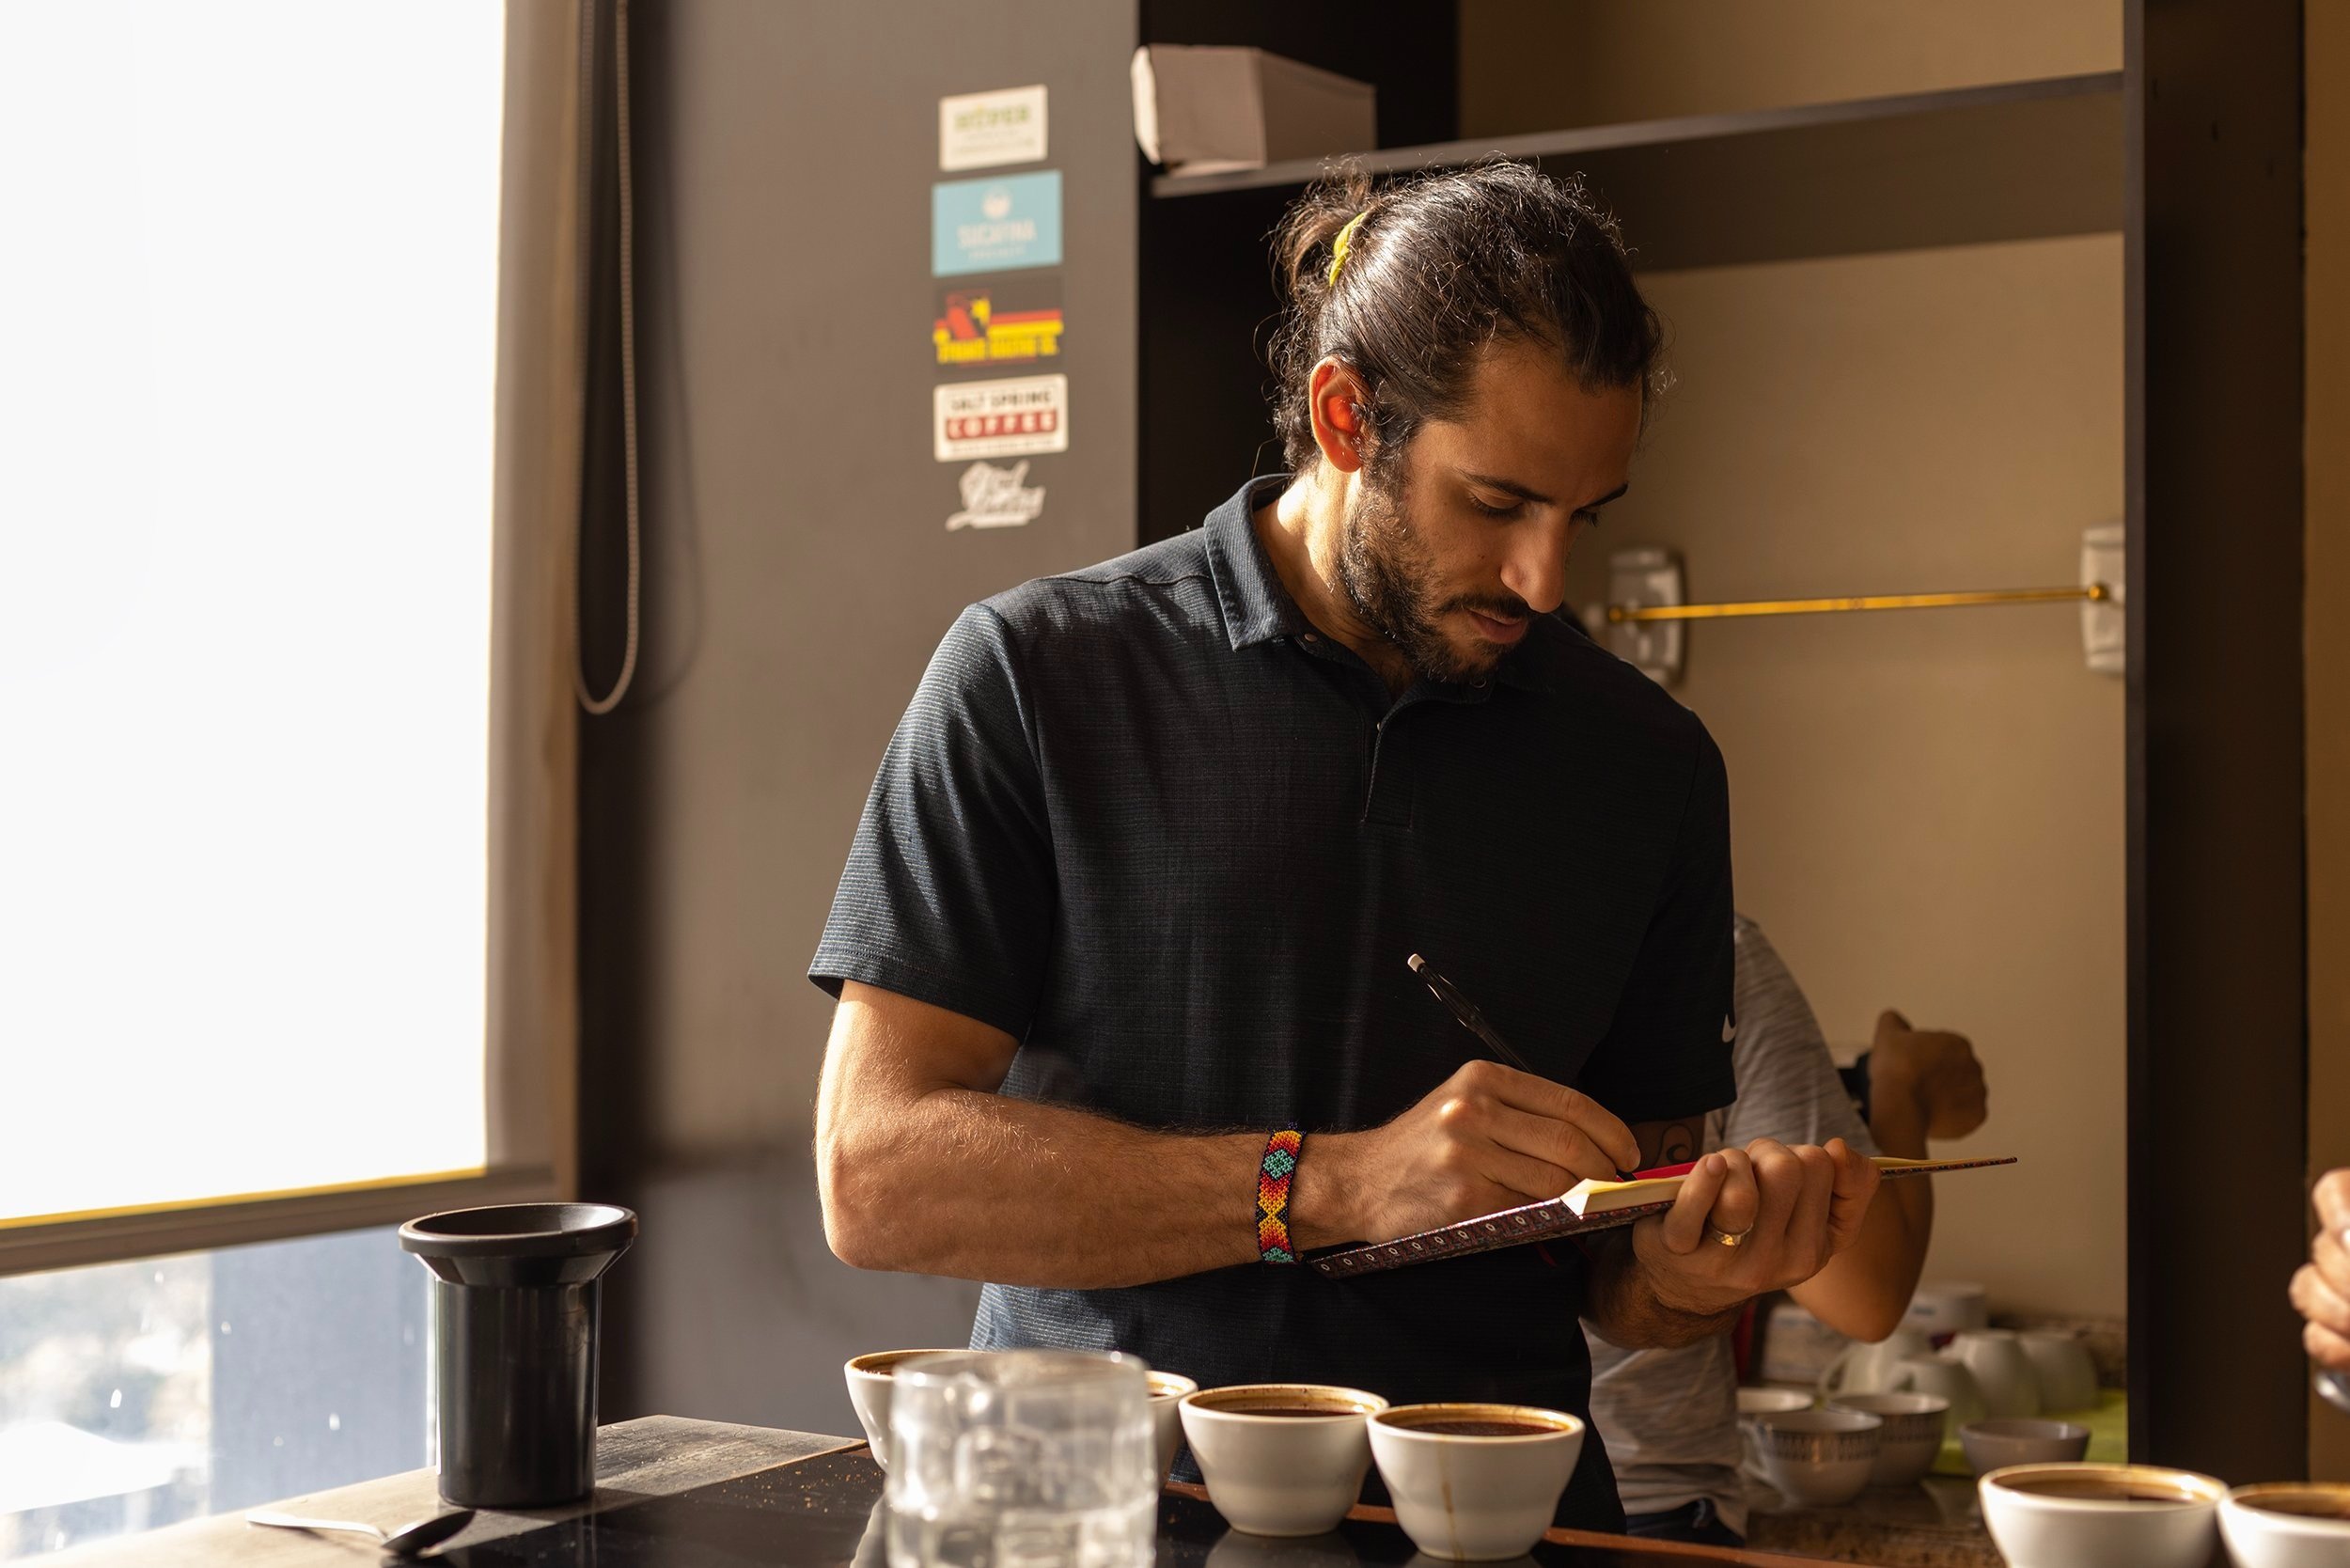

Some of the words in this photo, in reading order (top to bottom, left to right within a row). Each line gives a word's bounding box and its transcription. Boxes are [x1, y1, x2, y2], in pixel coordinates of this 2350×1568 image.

[951, 396, 984, 411] SALT
[991, 391, 1051, 407] SPRING
[948, 411, 1056, 439] COFFEE
